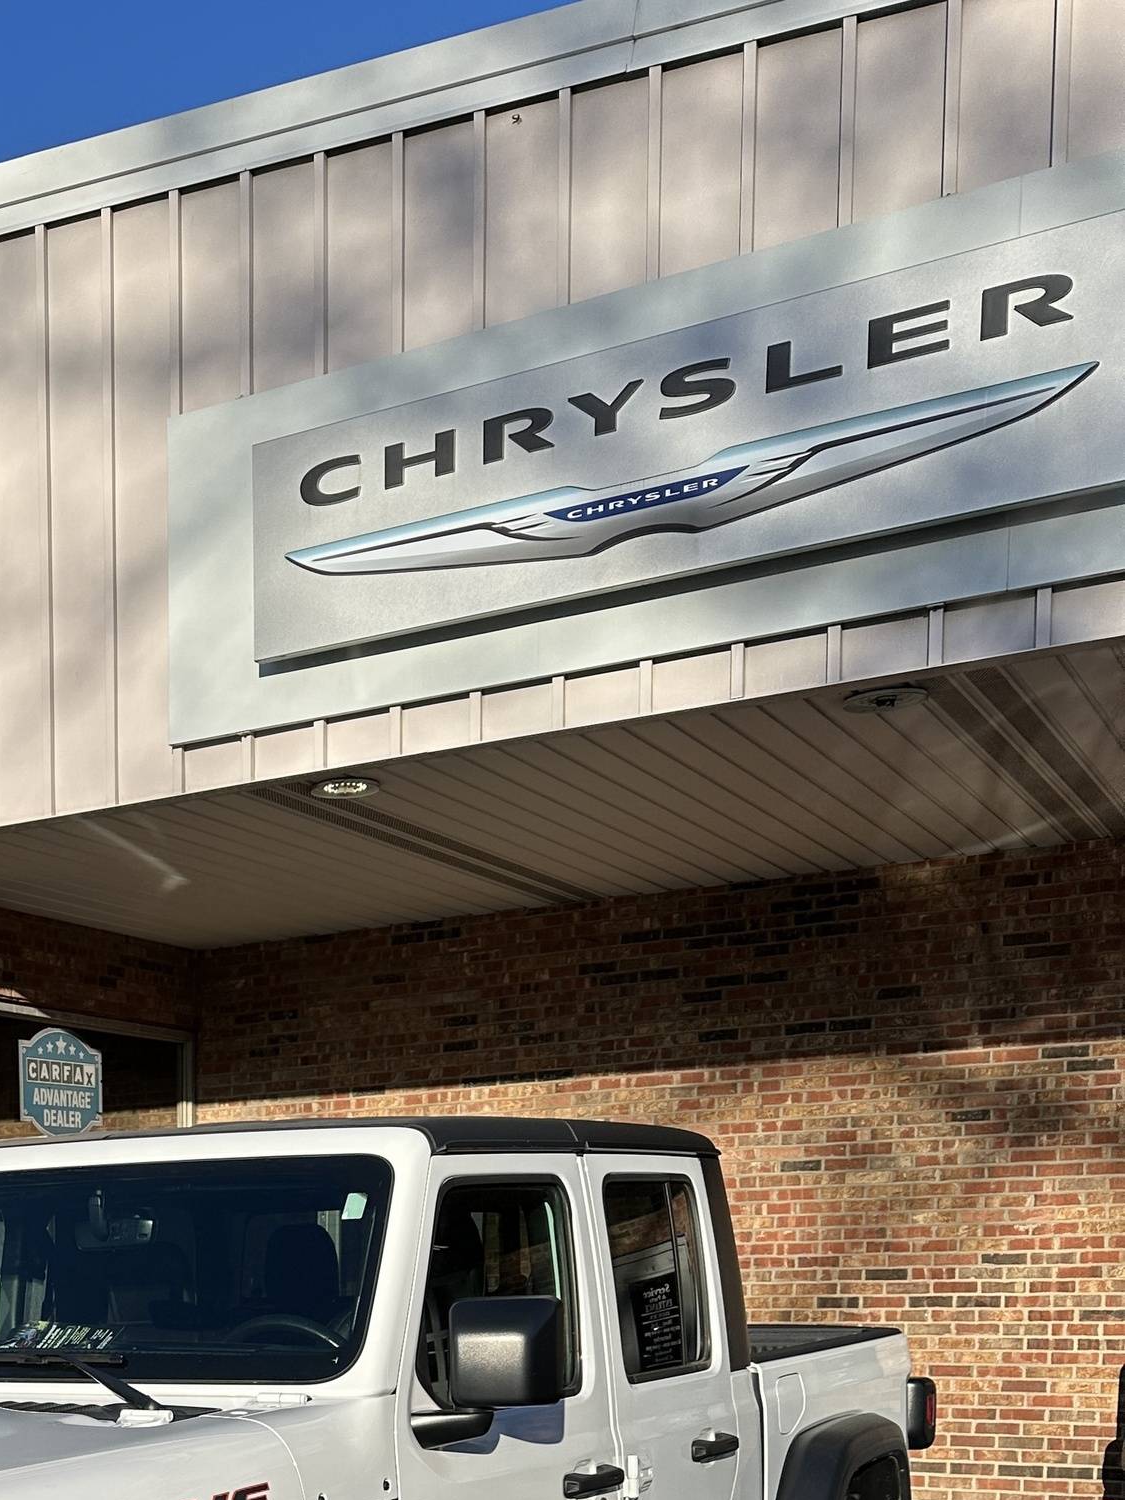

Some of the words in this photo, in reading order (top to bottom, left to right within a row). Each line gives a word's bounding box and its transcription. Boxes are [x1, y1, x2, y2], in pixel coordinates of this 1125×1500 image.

[300, 273, 1075, 508] CHRYSLER
[567, 478, 719, 519] CHRYSLER
[28, 1062, 93, 1086] CARFAX
[33, 1088, 92, 1109] ADVANTAGE
[43, 1111, 82, 1128] DEALER
